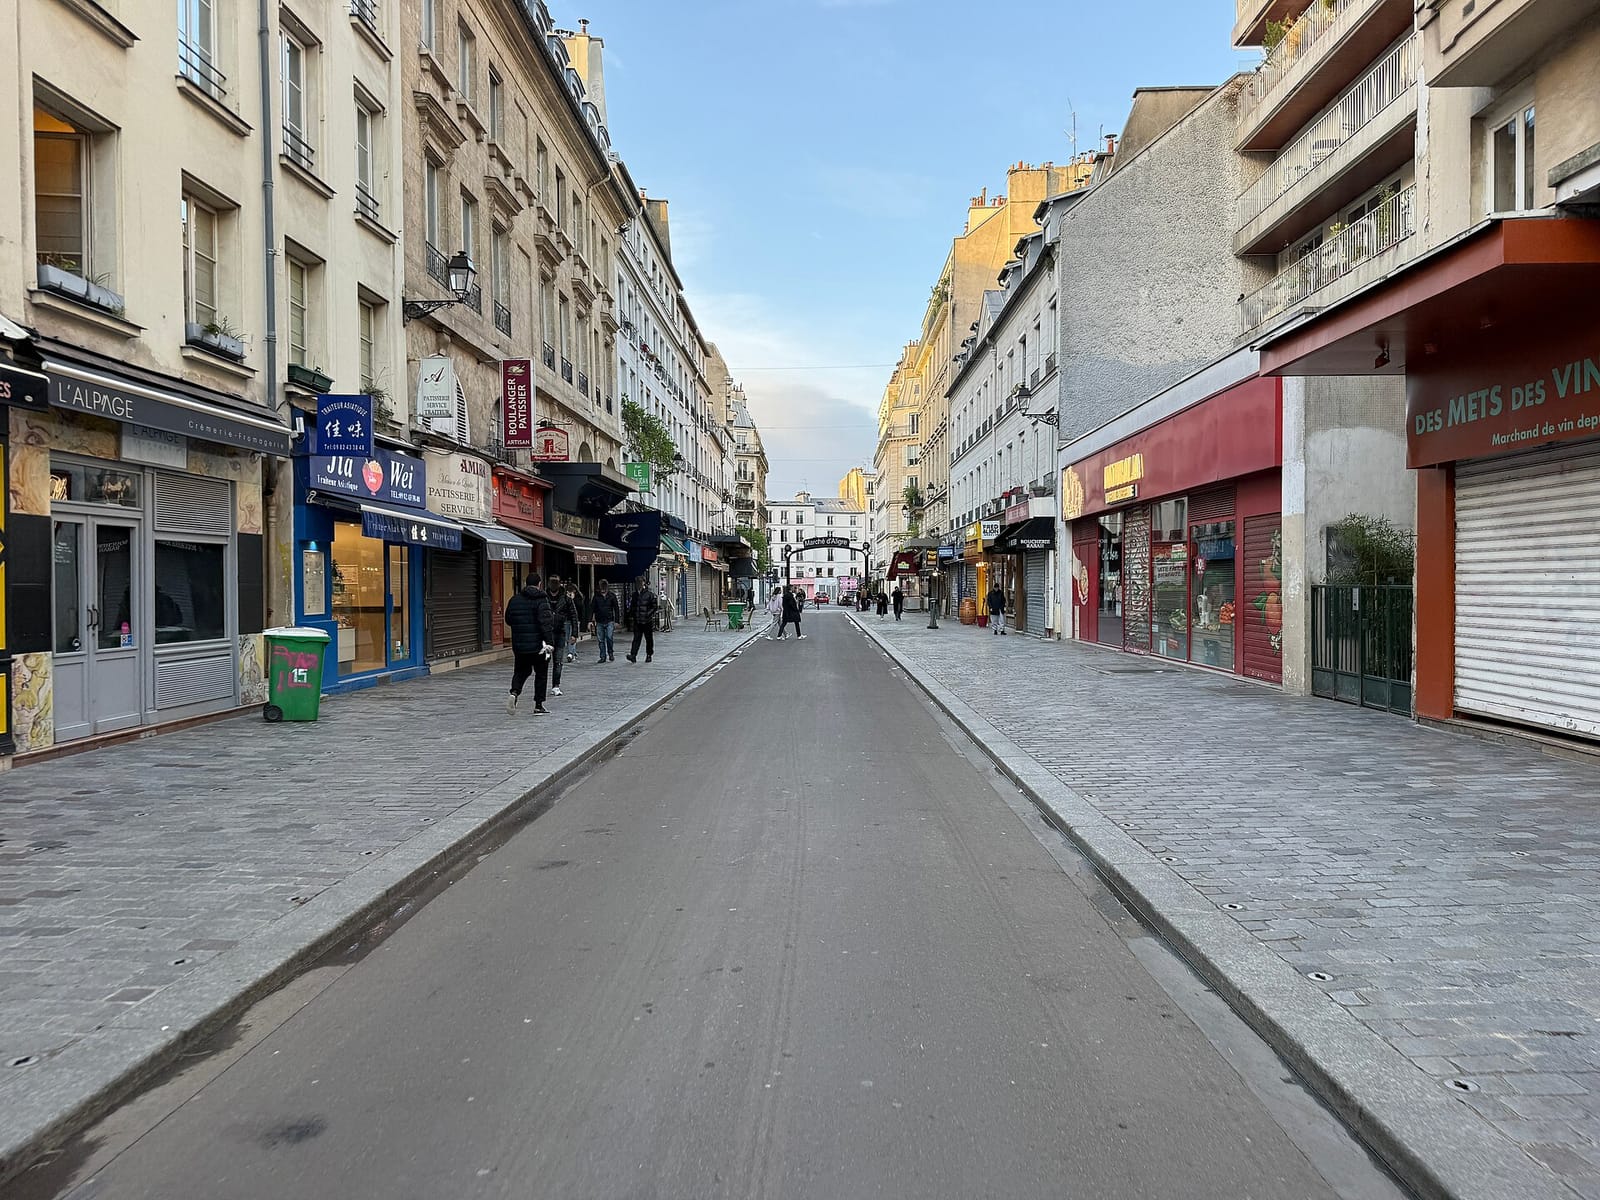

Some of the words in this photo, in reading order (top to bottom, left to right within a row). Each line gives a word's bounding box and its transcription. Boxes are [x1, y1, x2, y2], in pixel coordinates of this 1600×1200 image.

[58, 382, 134, 420] L'ALPAGE
[507, 378, 518, 436] BOULANGER
[518, 384, 528, 430] PATISSIER
[1415, 409, 1443, 435] DES
[1447, 385, 1503, 428] METS
[1511, 379, 1546, 411] DES
[325, 419, 364, 438] 佳味
[1492, 424, 1539, 446] Marchand
[1541, 421, 1555, 436] de
[1557, 418, 1574, 433] vin
[390, 460, 414, 490] Wei
[460, 459, 486, 479] AMIRA
[633, 469, 642, 477] LE
[317, 474, 337, 487] Traiteur
[428, 487, 476, 502] PATISSERIE
[440, 503, 475, 515] SERVICE
[804, 538, 826, 546] Marché
[502, 547, 519, 560] AMIRA
[291, 668, 308, 683] 15
